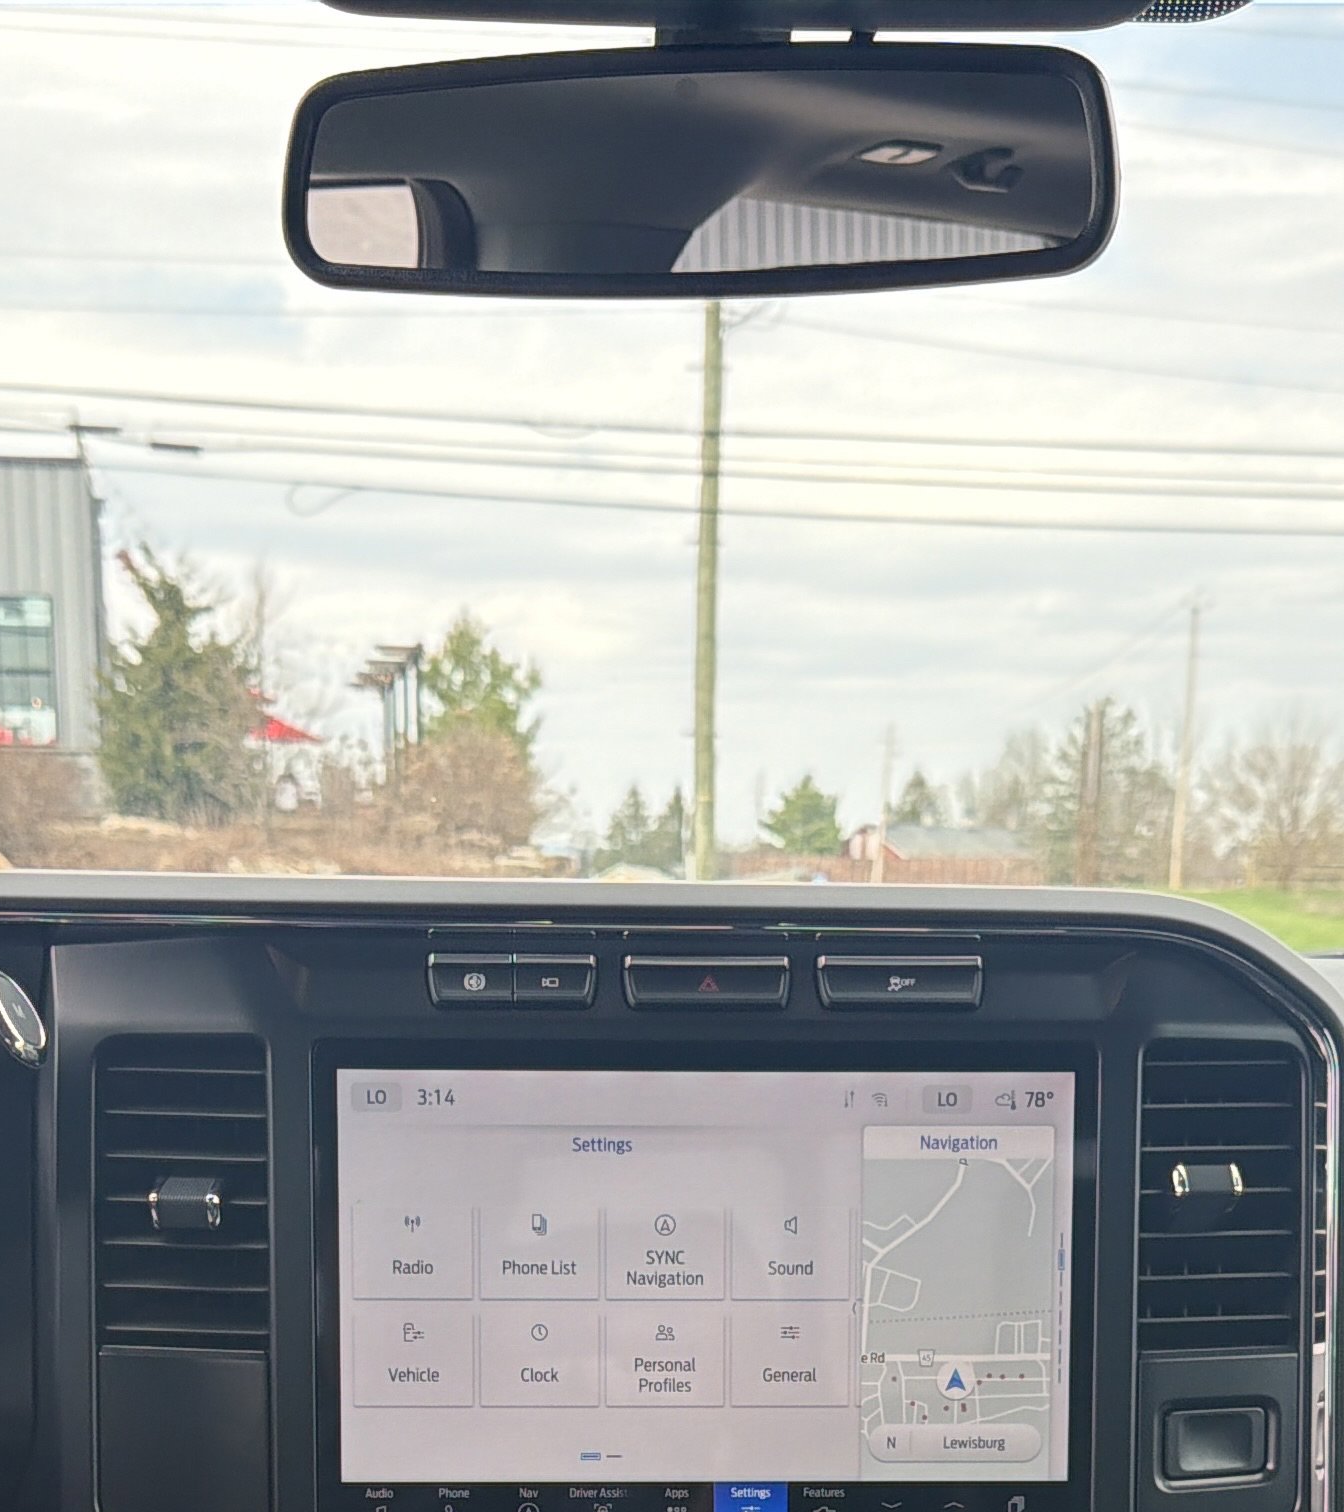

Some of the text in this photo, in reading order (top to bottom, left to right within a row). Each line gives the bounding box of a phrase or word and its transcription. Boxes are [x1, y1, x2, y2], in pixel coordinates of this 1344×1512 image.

[900, 978, 916, 987] OFF
[366, 1089, 387, 1105] LO
[417, 1088, 456, 1107] 3:14
[937, 1091, 958, 1108] LO
[1024, 1091, 1055, 1108] 78°
[572, 1136, 634, 1156] Settings
[920, 1134, 999, 1153] Navigation
[645, 1250, 686, 1266] SYNC
[392, 1259, 435, 1276] Radio
[502, 1259, 577, 1276] Phone List
[767, 1260, 815, 1277] Sound
[626, 1271, 705, 1289] Navigation
[633, 1356, 697, 1373] Personal
[870, 1351, 886, 1364] Rd
[388, 1367, 441, 1384] Vehicle
[519, 1367, 560, 1384] Clock
[762, 1367, 817, 1384] General
[638, 1377, 693, 1394] Profiles
[886, 1436, 897, 1450] N
[942, 1435, 1006, 1452] Lewisburg
[364, 1486, 395, 1500] Audio
[437, 1486, 471, 1500] Phone
[518, 1486, 539, 1500] Nav
[568, 1486, 629, 1500] Driver Assist
[664, 1486, 690, 1502] Apps
[730, 1486, 772, 1501] Settings
[803, 1486, 846, 1499] Features
